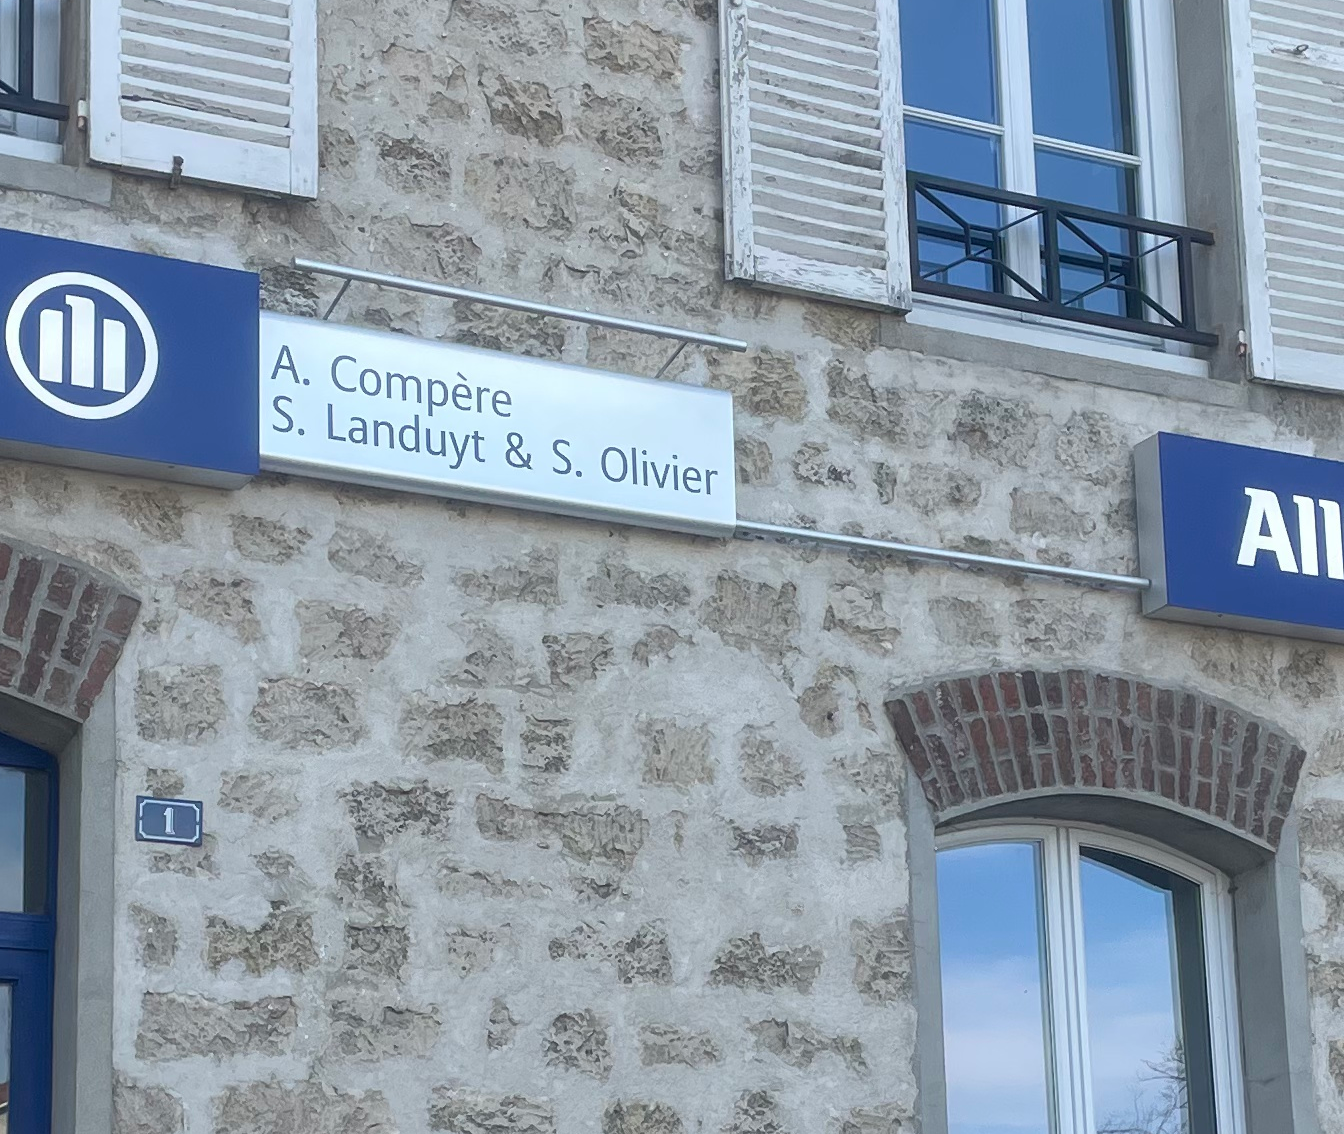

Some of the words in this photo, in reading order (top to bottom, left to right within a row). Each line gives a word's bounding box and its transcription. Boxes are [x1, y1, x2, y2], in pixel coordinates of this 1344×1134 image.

[271, 345, 310, 385] A.
[330, 355, 513, 417] Compère
[272, 395, 305, 435] S.
[327, 403, 485, 469] Landuyt
[505, 432, 533, 469] &
[552, 439, 583, 477] S.
[601, 446, 718, 495] Olivier
[163, 807, 175, 835] 1
